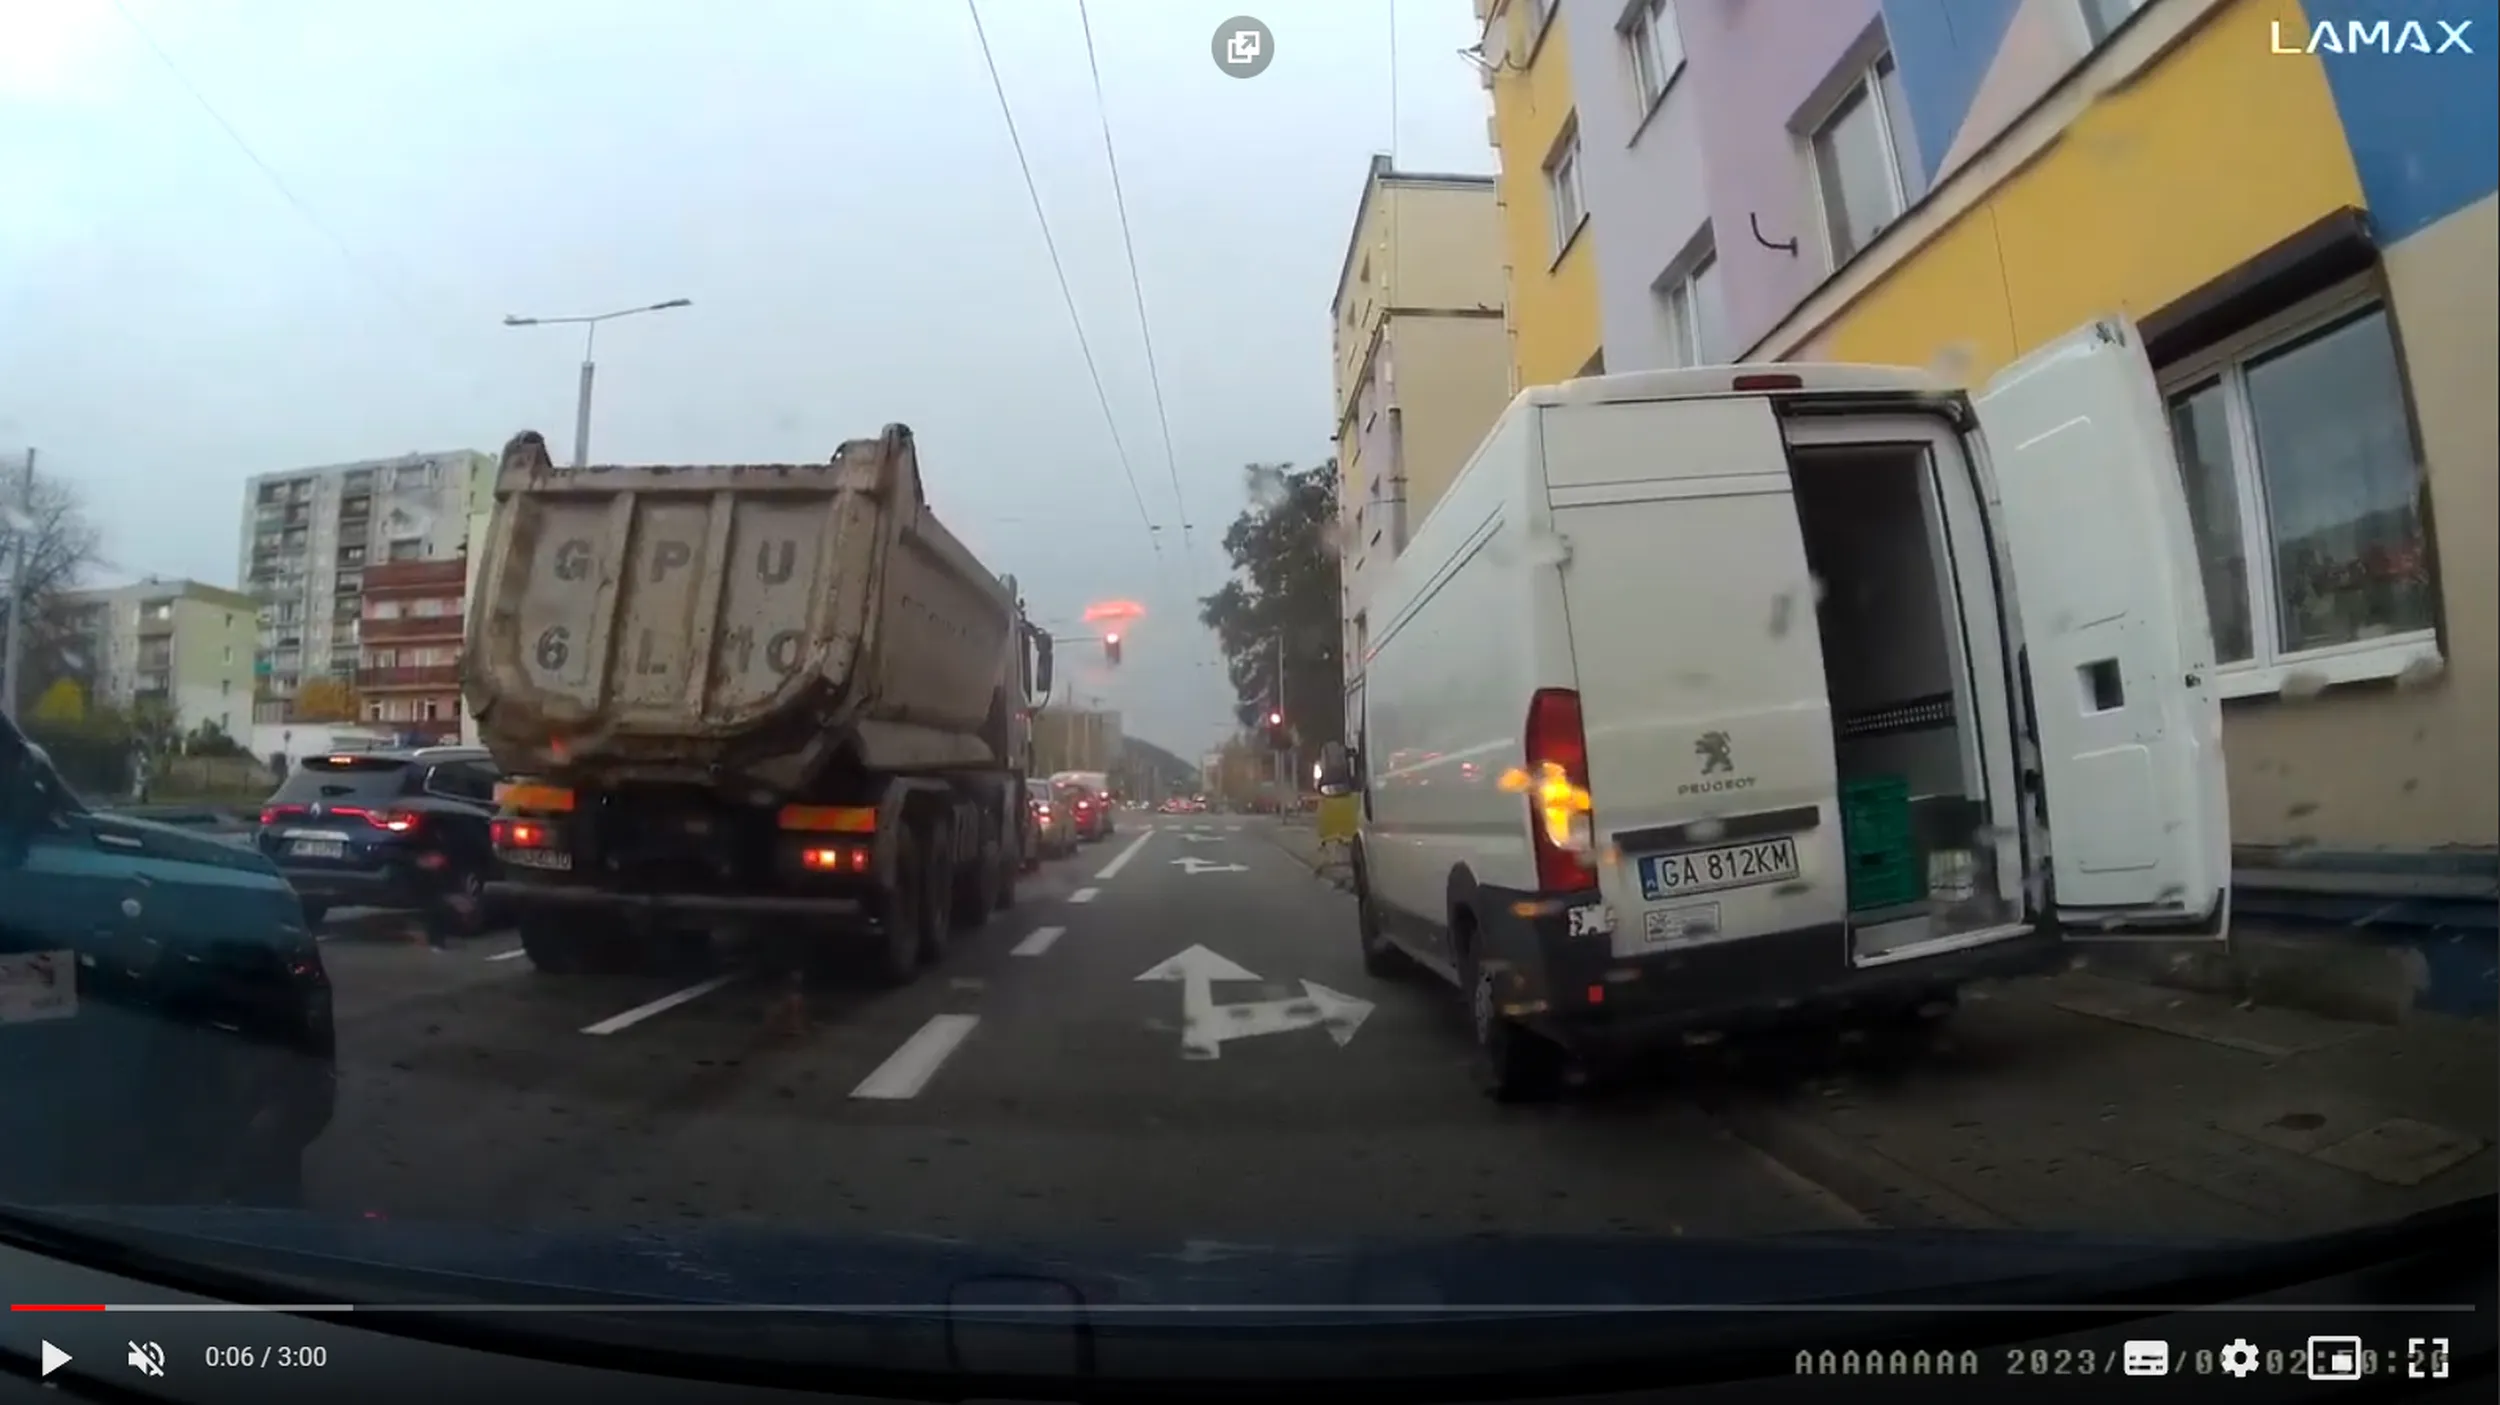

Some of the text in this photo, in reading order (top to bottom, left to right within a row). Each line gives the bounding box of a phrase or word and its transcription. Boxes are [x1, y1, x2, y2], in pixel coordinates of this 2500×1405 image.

[1677, 776, 1756, 795] PEUGEOT
[1662, 842, 1790, 887] GA 812KM
